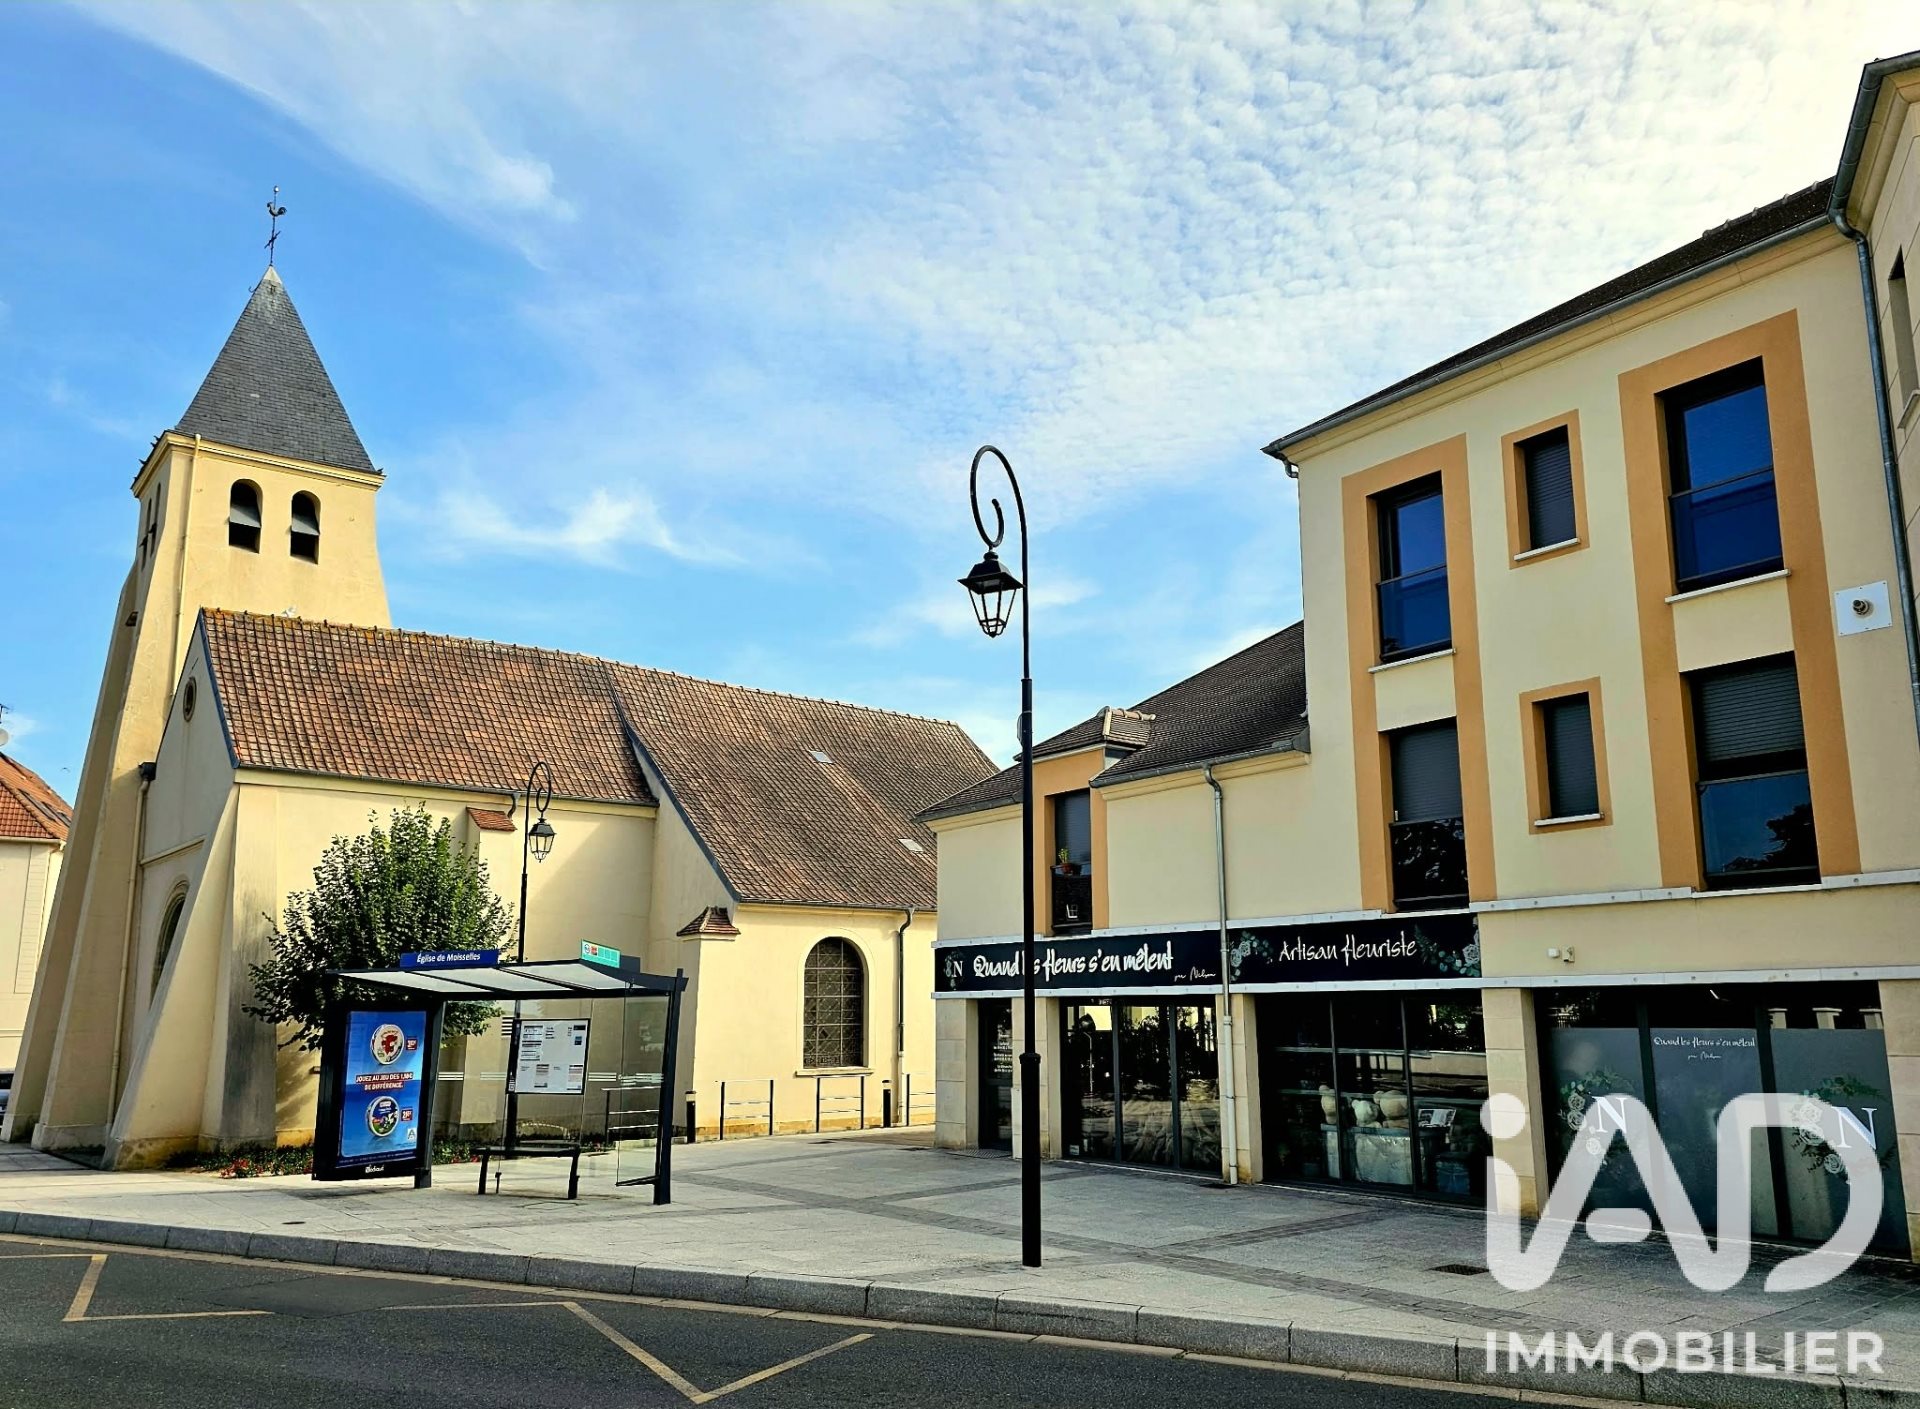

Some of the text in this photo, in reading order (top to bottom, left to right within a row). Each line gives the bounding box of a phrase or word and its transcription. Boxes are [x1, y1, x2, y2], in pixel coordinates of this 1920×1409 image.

[417, 951, 481, 964] Église de Moisselles
[973, 950, 1020, 977] Quand
[1021, 949, 1041, 976] ls
[1042, 948, 1085, 982] fleurs
[1123, 940, 1174, 971] mêlent
[1279, 930, 1417, 966] Artisan fleuriste
[1653, 1036, 1679, 1046] Quand
[1692, 1036, 1714, 1048] fleurs
[356, 1075, 372, 1083] JOUEZ
[1593, 1096, 1627, 1133] N
[1832, 1106, 1877, 1150] N
